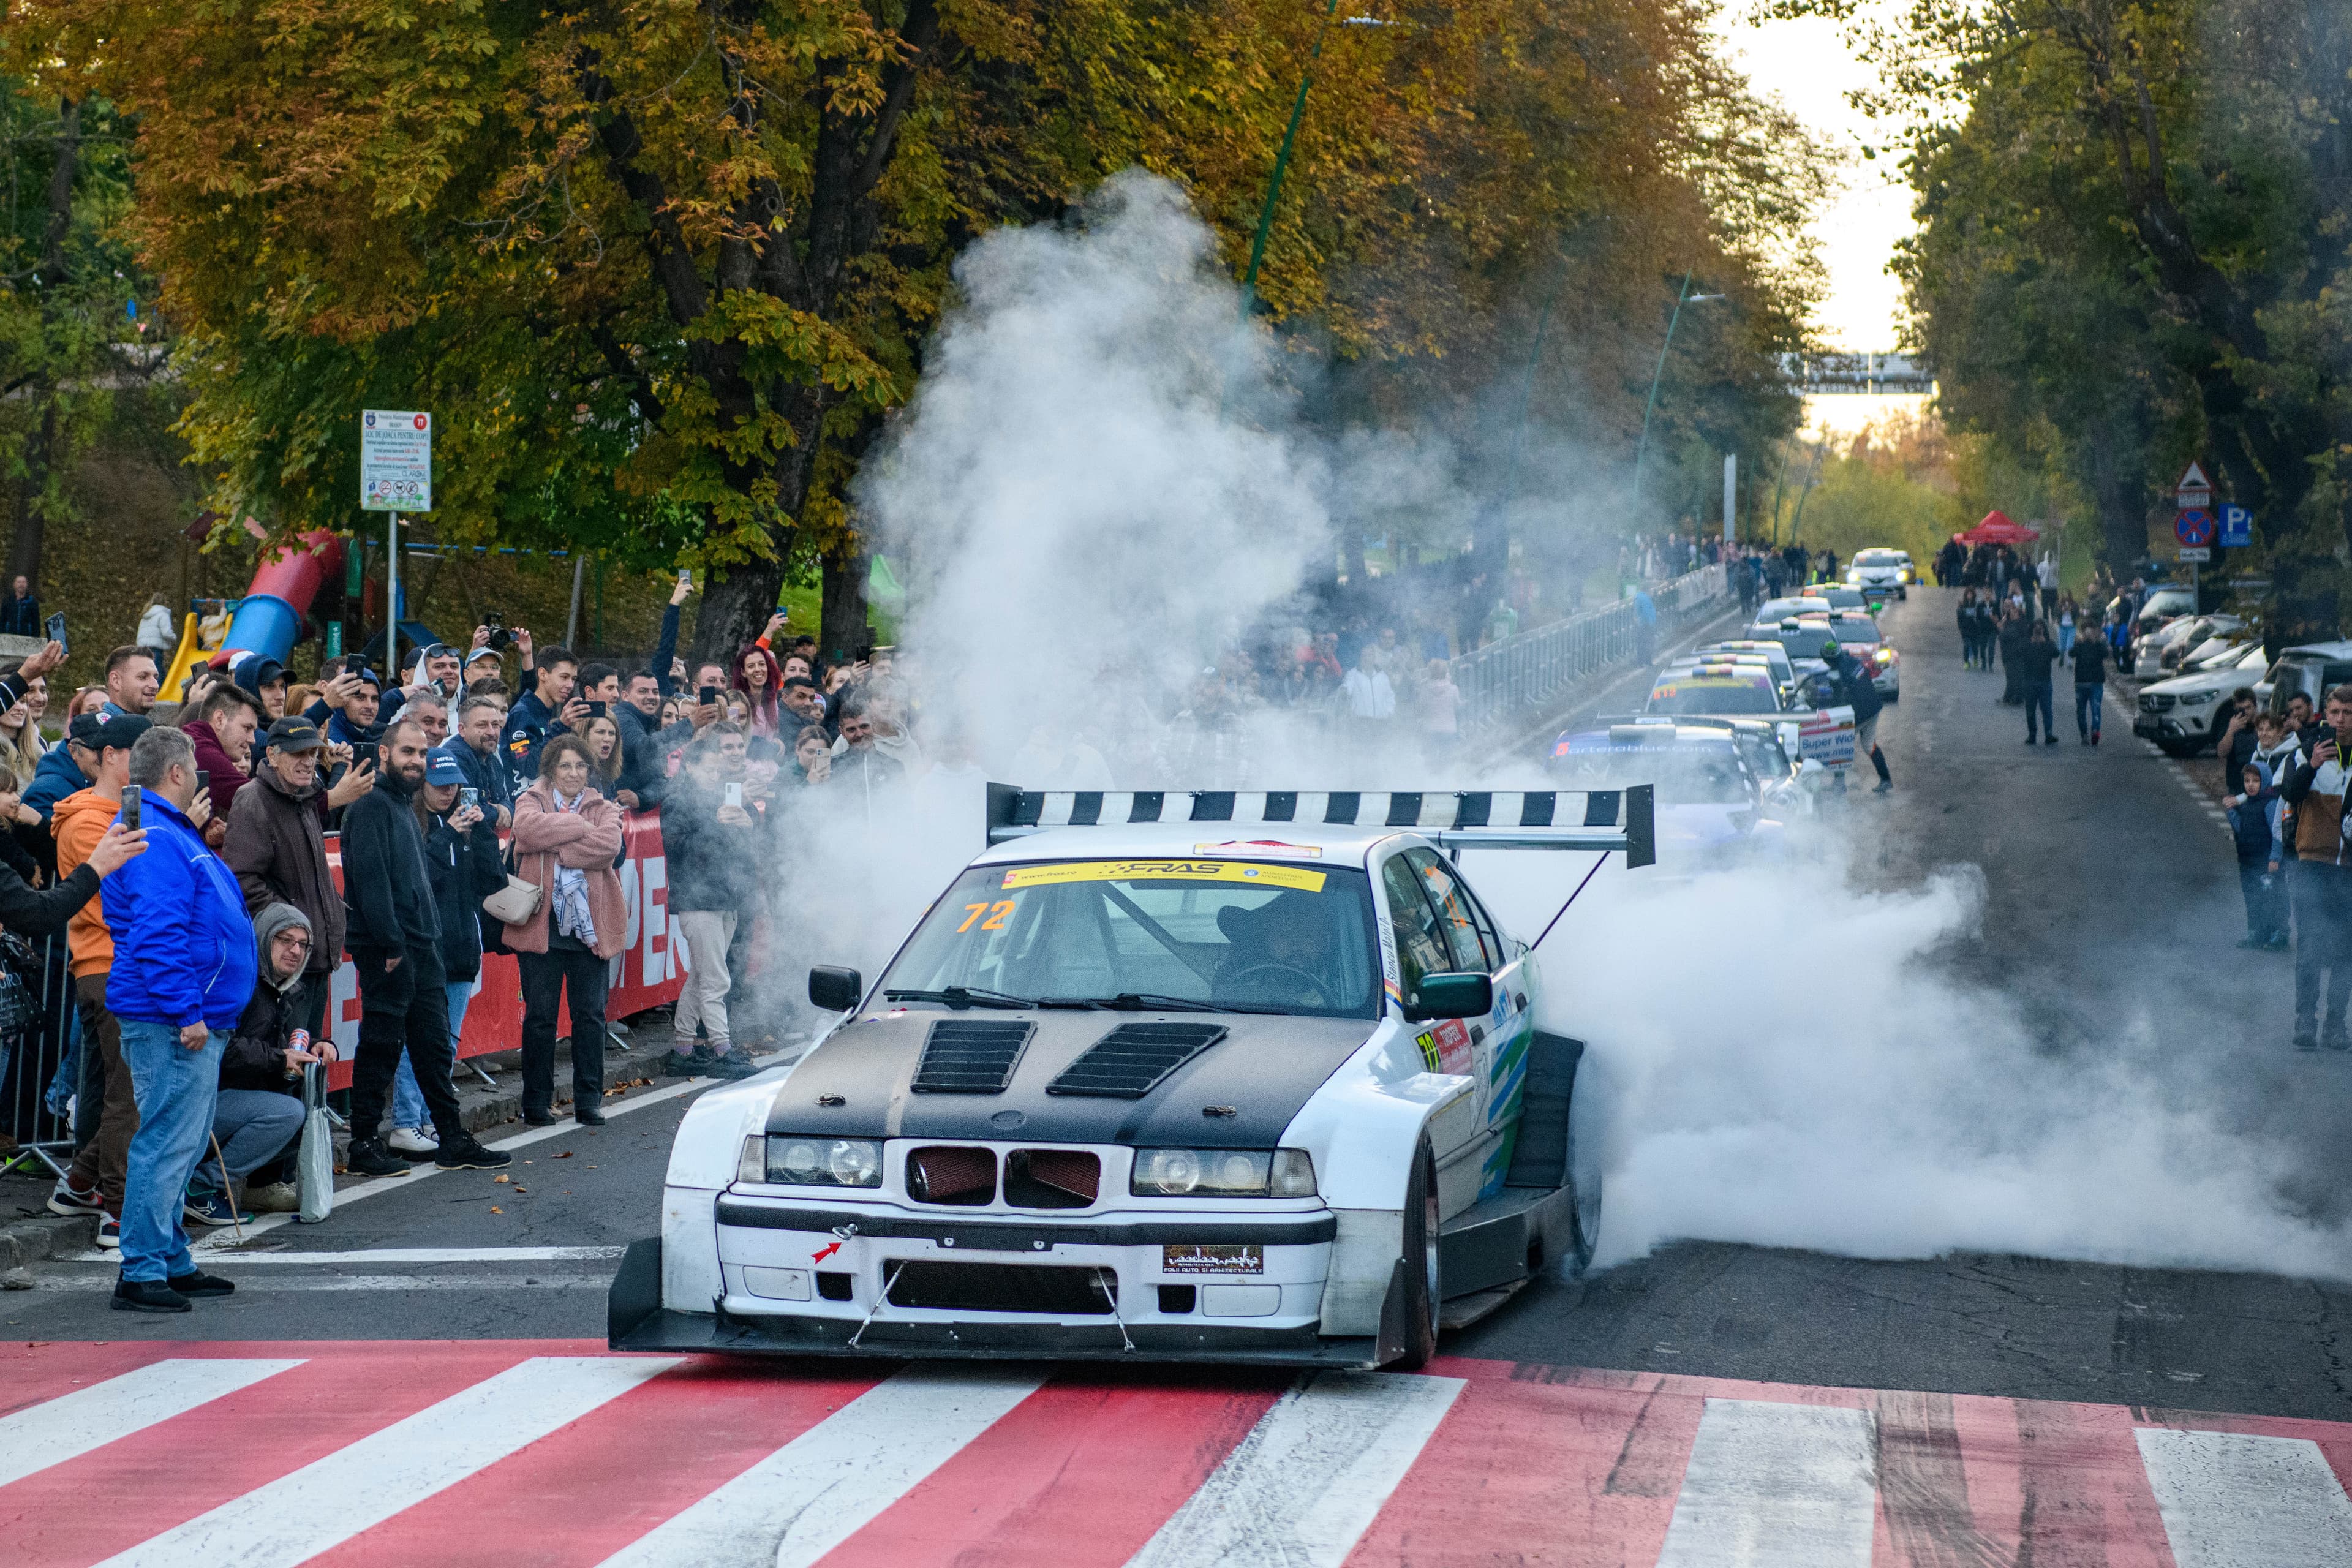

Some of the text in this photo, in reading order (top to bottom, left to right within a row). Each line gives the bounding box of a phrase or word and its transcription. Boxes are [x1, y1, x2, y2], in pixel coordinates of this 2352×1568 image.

[2228, 507, 2245, 532] P
[1803, 732, 1855, 750] Super Wid
[1126, 863, 1224, 873] FRAS
[957, 900, 1016, 933] 72
[1387, 950, 1398, 983] Stancu
